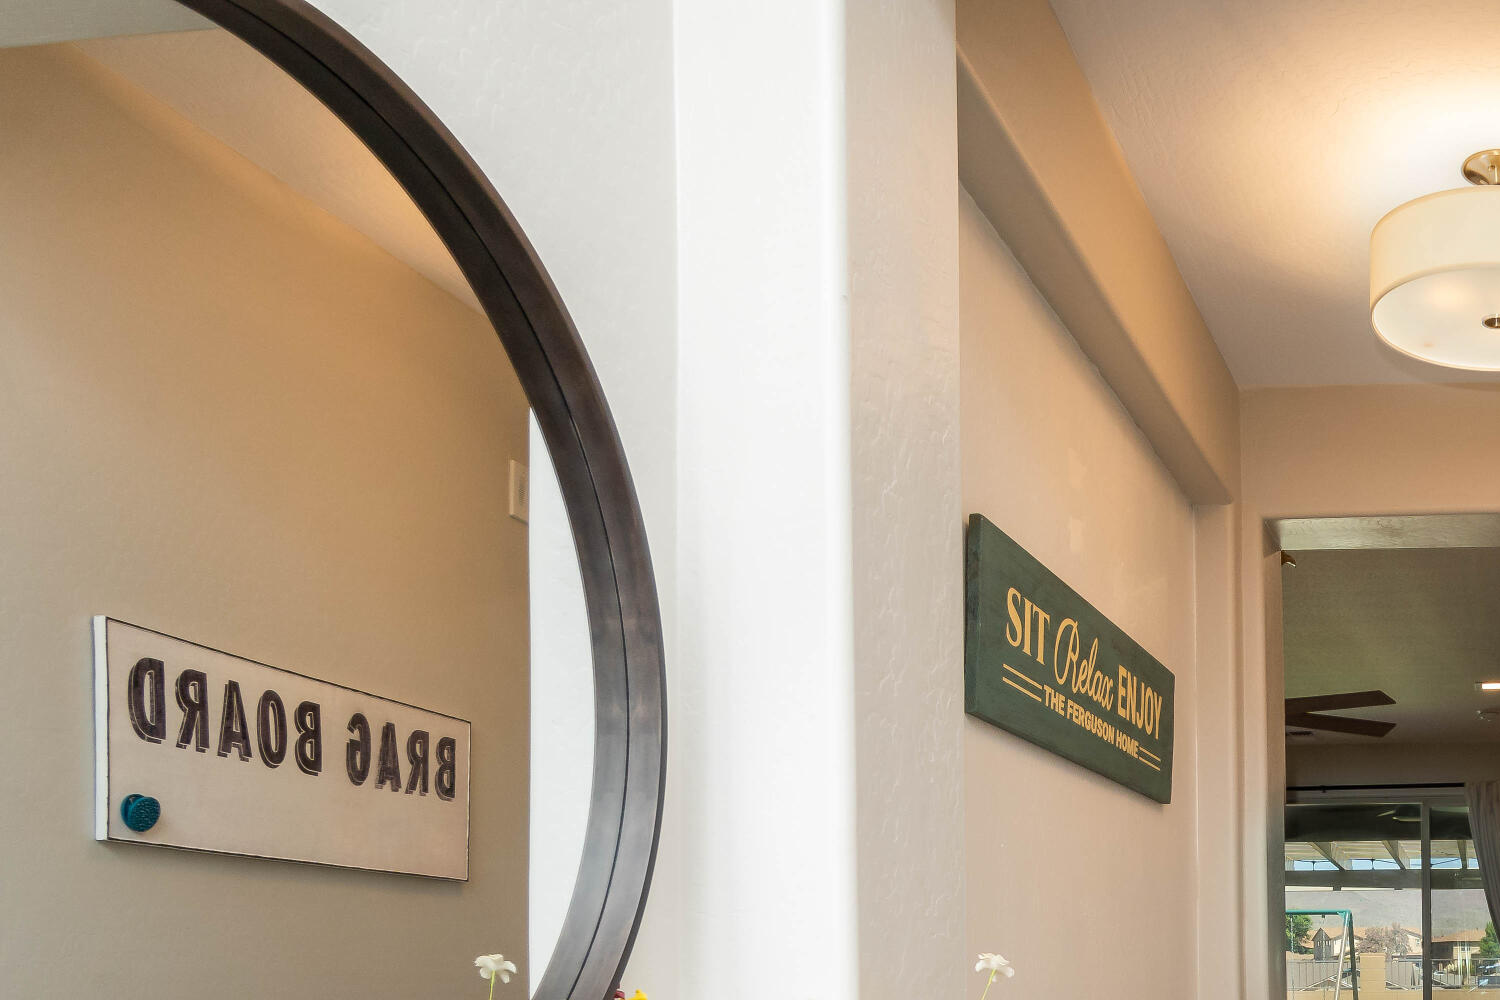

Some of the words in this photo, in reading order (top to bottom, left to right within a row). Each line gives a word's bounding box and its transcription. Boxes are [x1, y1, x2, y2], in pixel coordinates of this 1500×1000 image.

[1006, 587, 1049, 665] SIT
[1054, 618, 1114, 712] Relax
[1117, 664, 1162, 740] ENJOY
[1044, 684, 1065, 716] THE
[1067, 699, 1115, 744] FERGUSON
[1116, 729, 1139, 759] HOME
